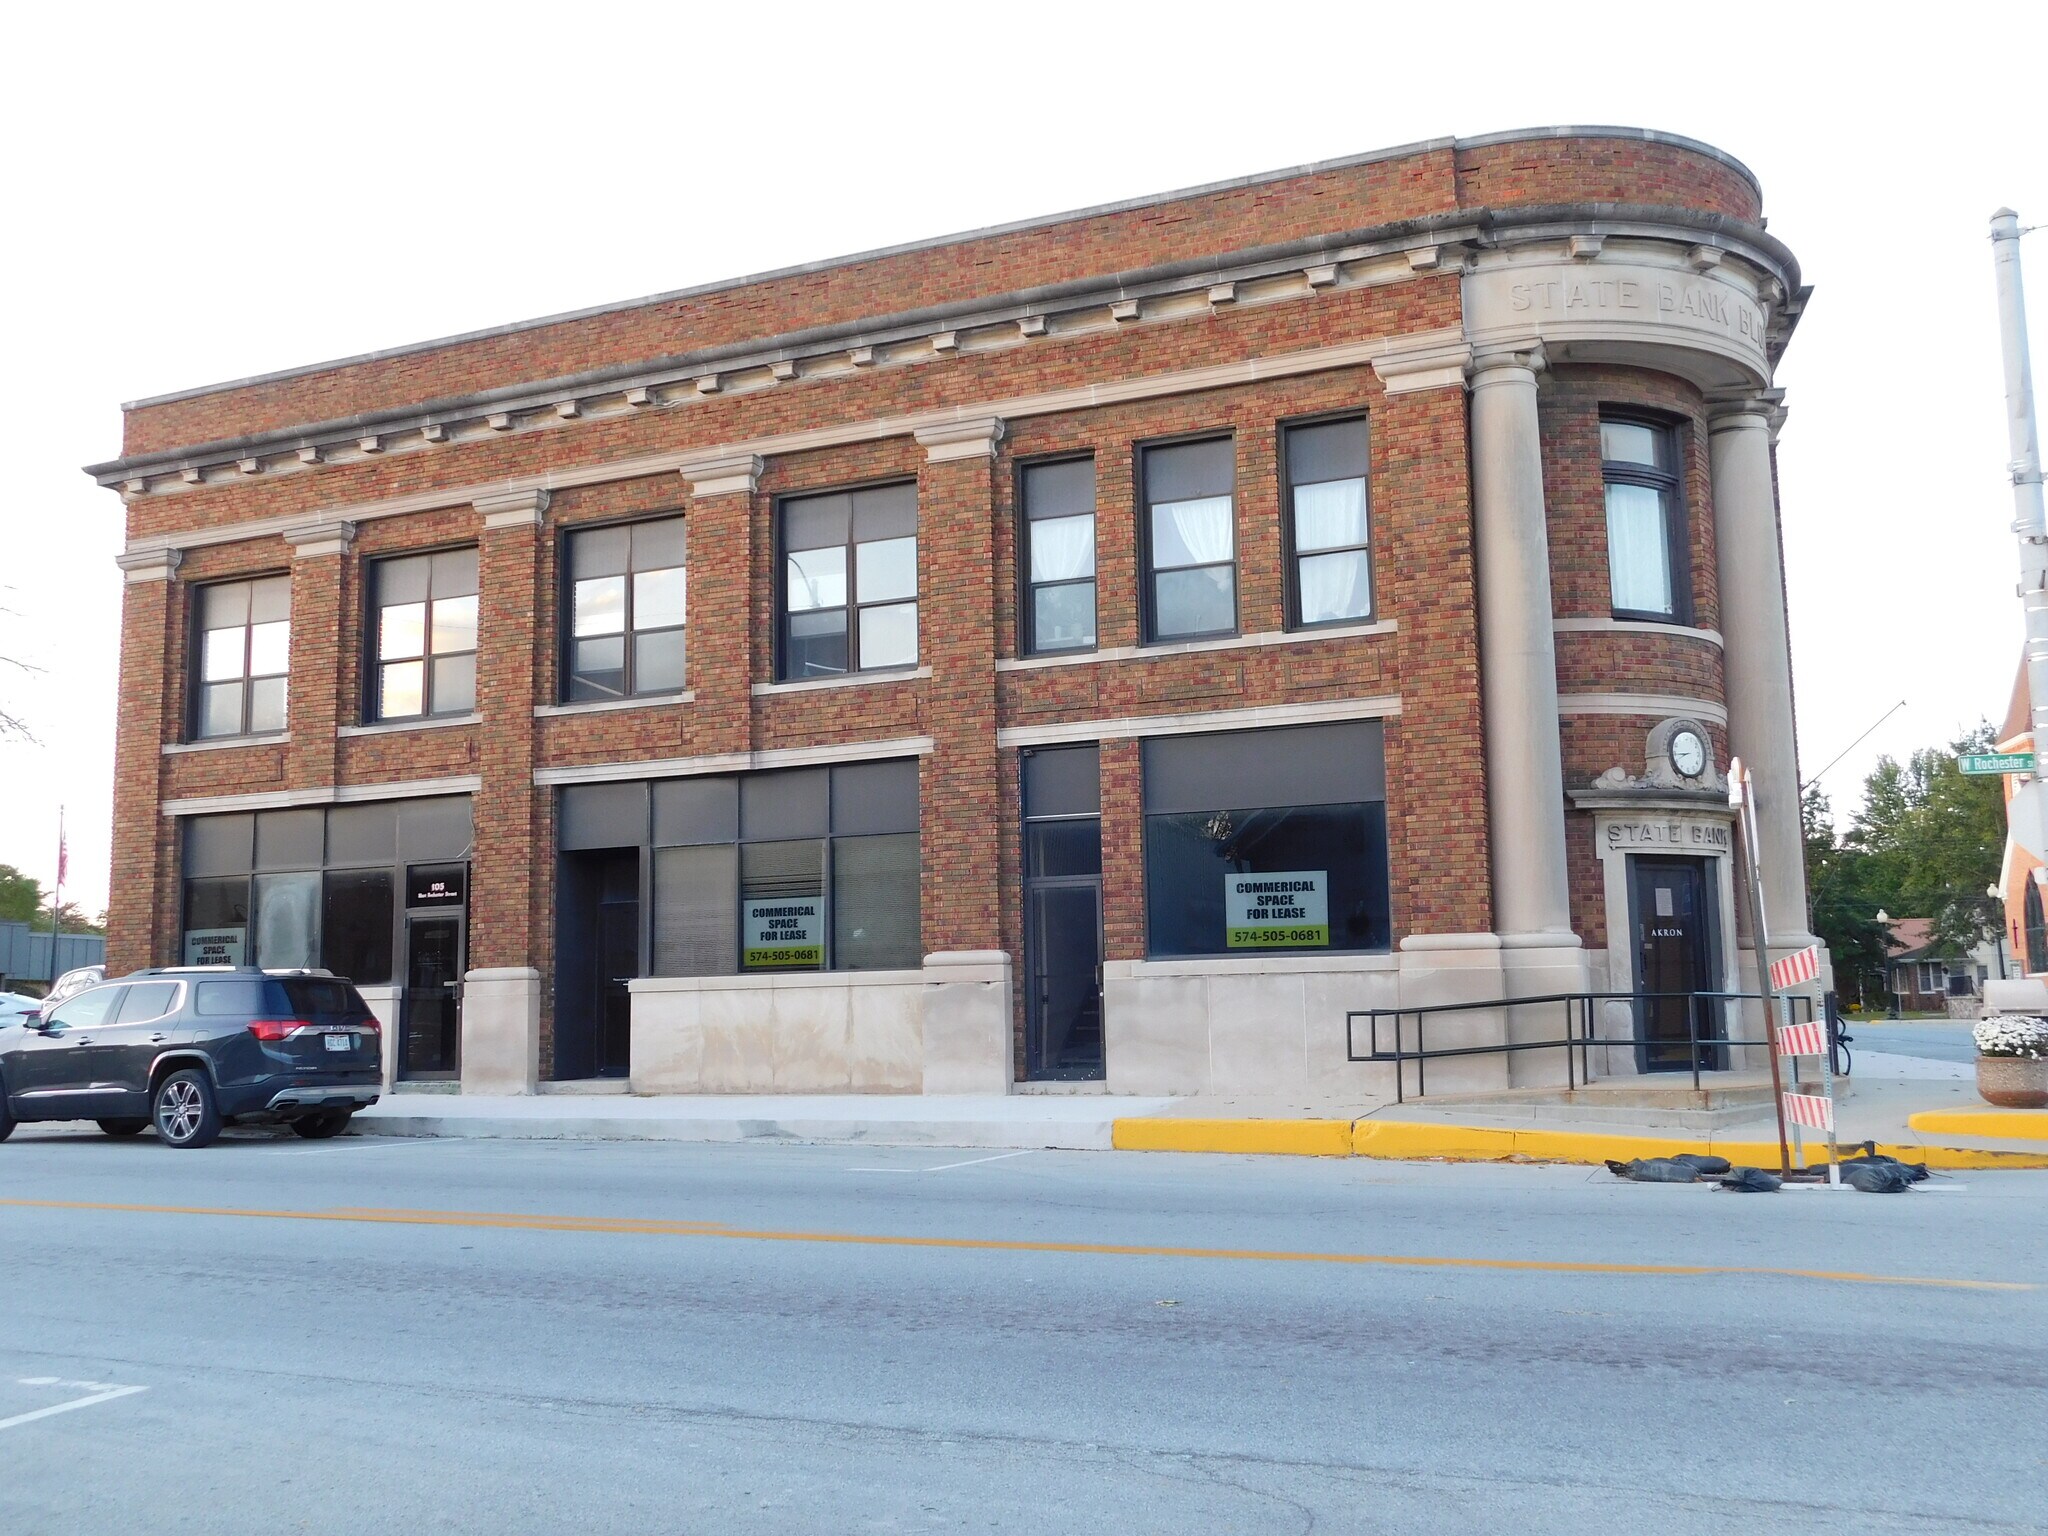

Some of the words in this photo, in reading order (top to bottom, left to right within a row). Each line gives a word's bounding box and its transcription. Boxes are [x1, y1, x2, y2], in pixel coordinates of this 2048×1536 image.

[1511, 280, 1640, 311] STATE
[1658, 281, 1729, 326] BANK
[1960, 758, 1970, 771] W
[1974, 756, 2024, 770] Rochester
[1607, 823, 1681, 843] STATE
[1691, 825, 1728, 846] BANK
[431, 882, 445, 891] 105
[1236, 881, 1315, 894] COMMERICAL
[1257, 895, 1295, 906] SPACE
[752, 906, 816, 918] COMMERICAL
[1246, 909, 1269, 919] FOR
[1271, 908, 1306, 918] LEASE
[768, 919, 798, 929] SPACE
[760, 931, 778, 941] FOR
[780, 930, 807, 940] LEASE
[1234, 930, 1321, 942] 574-505-0681
[1651, 929, 1683, 937] AKRON
[191, 935, 238, 946] COMMERICAL
[203, 946, 226, 955] SPACE
[749, 949, 819, 961] 574-505-0681
[196, 957, 210, 965] FOR
[211, 955, 231, 965] LEASE
